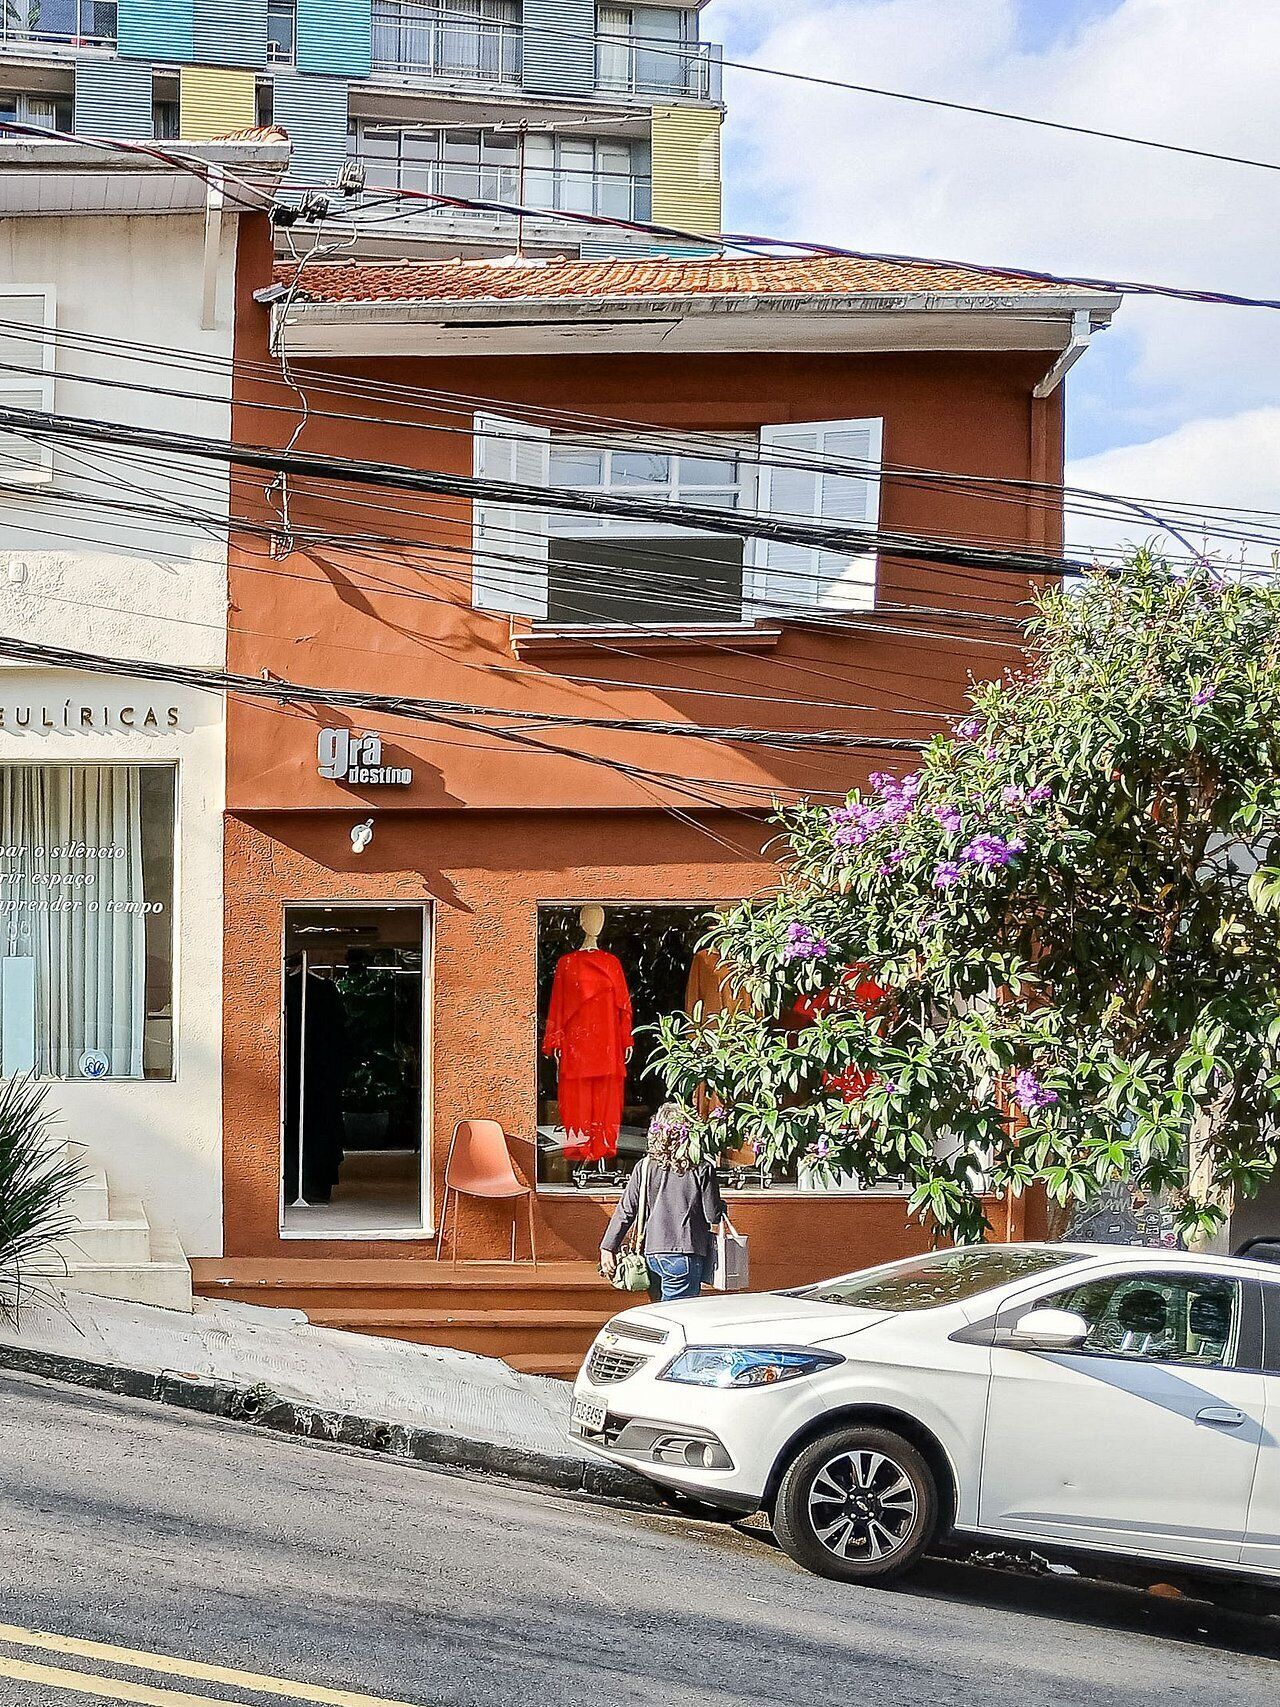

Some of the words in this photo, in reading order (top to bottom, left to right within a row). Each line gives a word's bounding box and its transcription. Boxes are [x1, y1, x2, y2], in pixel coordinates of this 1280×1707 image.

[348, 766, 412, 784] destino
[34, 845, 45, 858] o
[51, 841, 126, 859] silêncio
[31, 872, 96, 890] espaço
[88, 900, 99, 913] o
[106, 898, 164, 918] tempo
